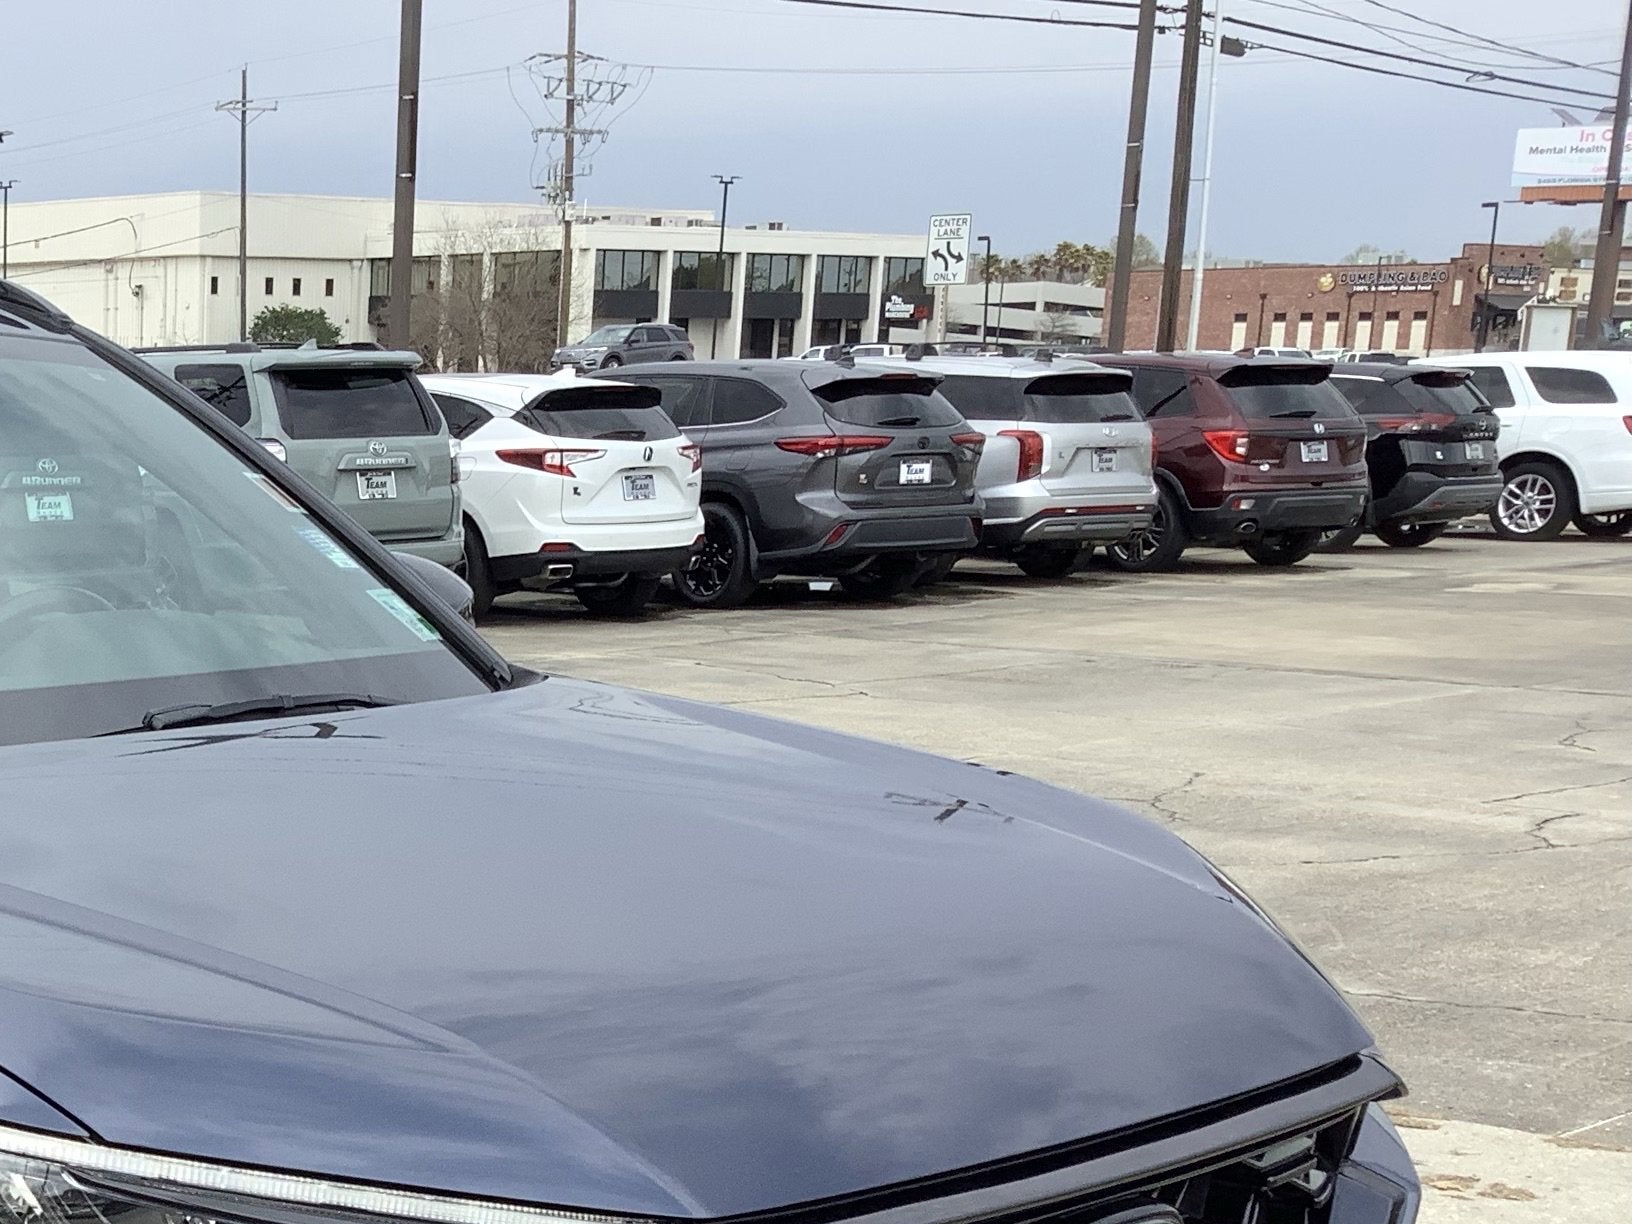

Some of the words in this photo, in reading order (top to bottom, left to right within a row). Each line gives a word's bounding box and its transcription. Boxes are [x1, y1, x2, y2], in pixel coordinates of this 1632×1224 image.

[1528, 145, 1567, 155] Mental
[1569, 145, 1607, 154] Health
[932, 217, 968, 228] CENTER
[937, 227, 962, 237] LANE
[933, 272, 958, 281] ONLY
[365, 477, 387, 489] TEAM
[630, 479, 649, 491] TEAM
[35, 497, 61, 510] TEAM
